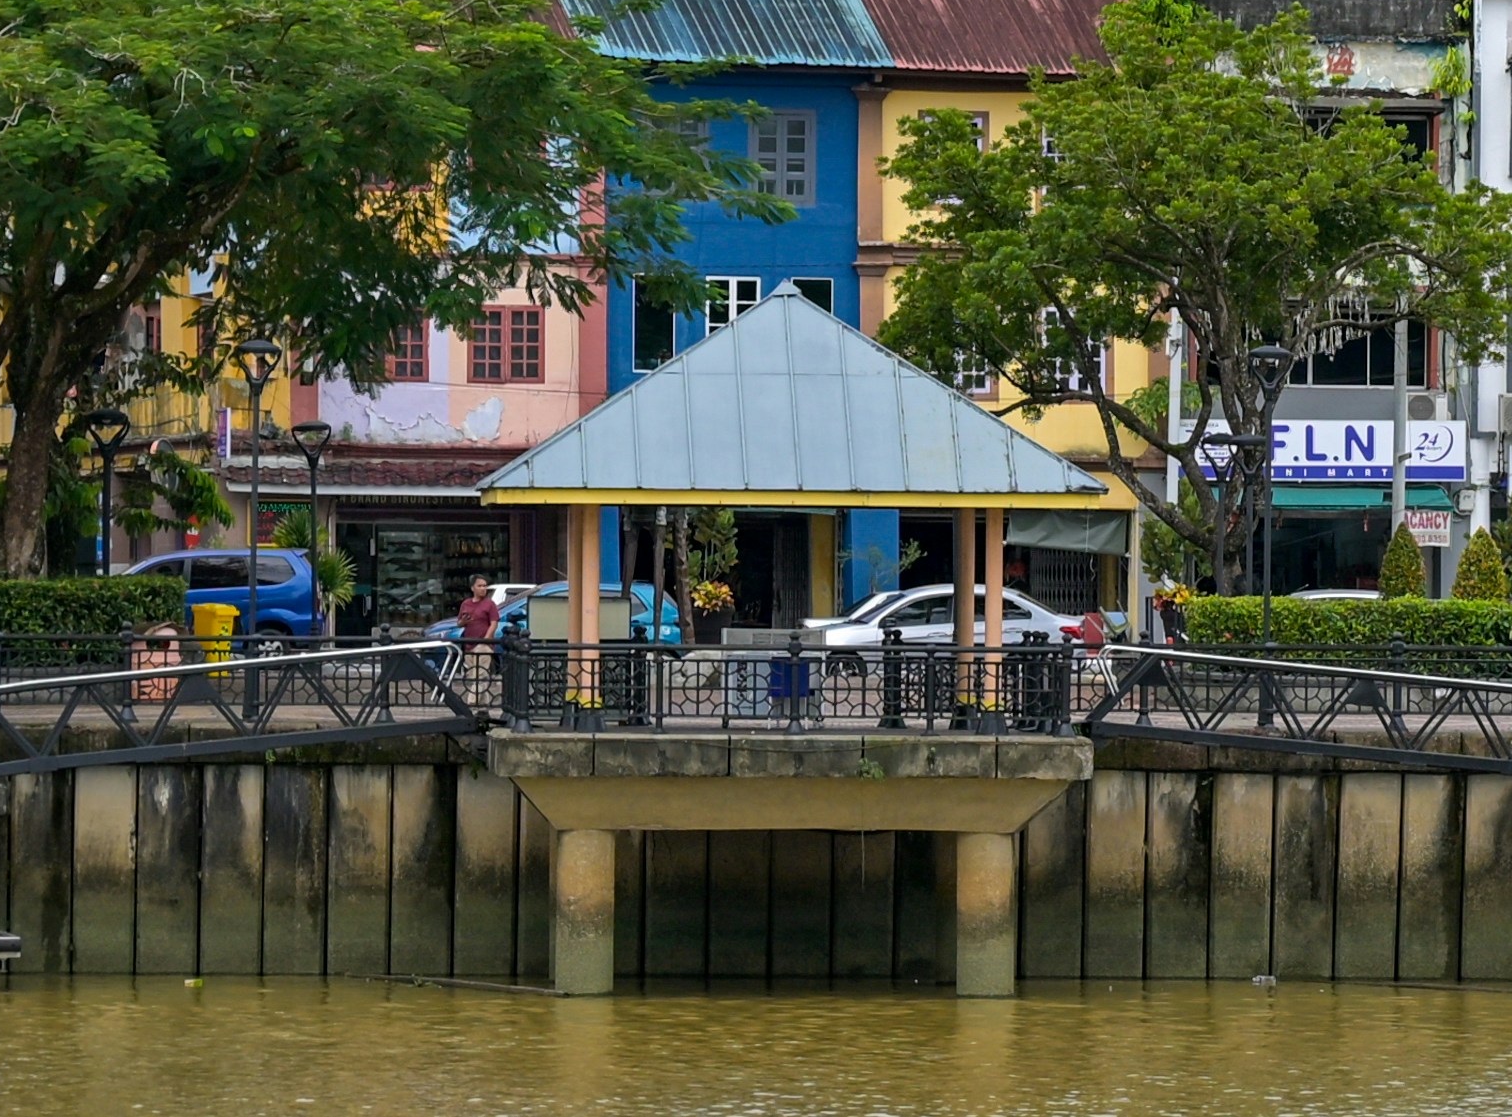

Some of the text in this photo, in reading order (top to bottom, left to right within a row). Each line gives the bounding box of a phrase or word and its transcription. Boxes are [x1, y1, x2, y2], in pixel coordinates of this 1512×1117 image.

[1414, 433, 1439, 451] 24
[1271, 468, 1388, 477] INI MART
[1404, 512, 1449, 530] ACANCY
